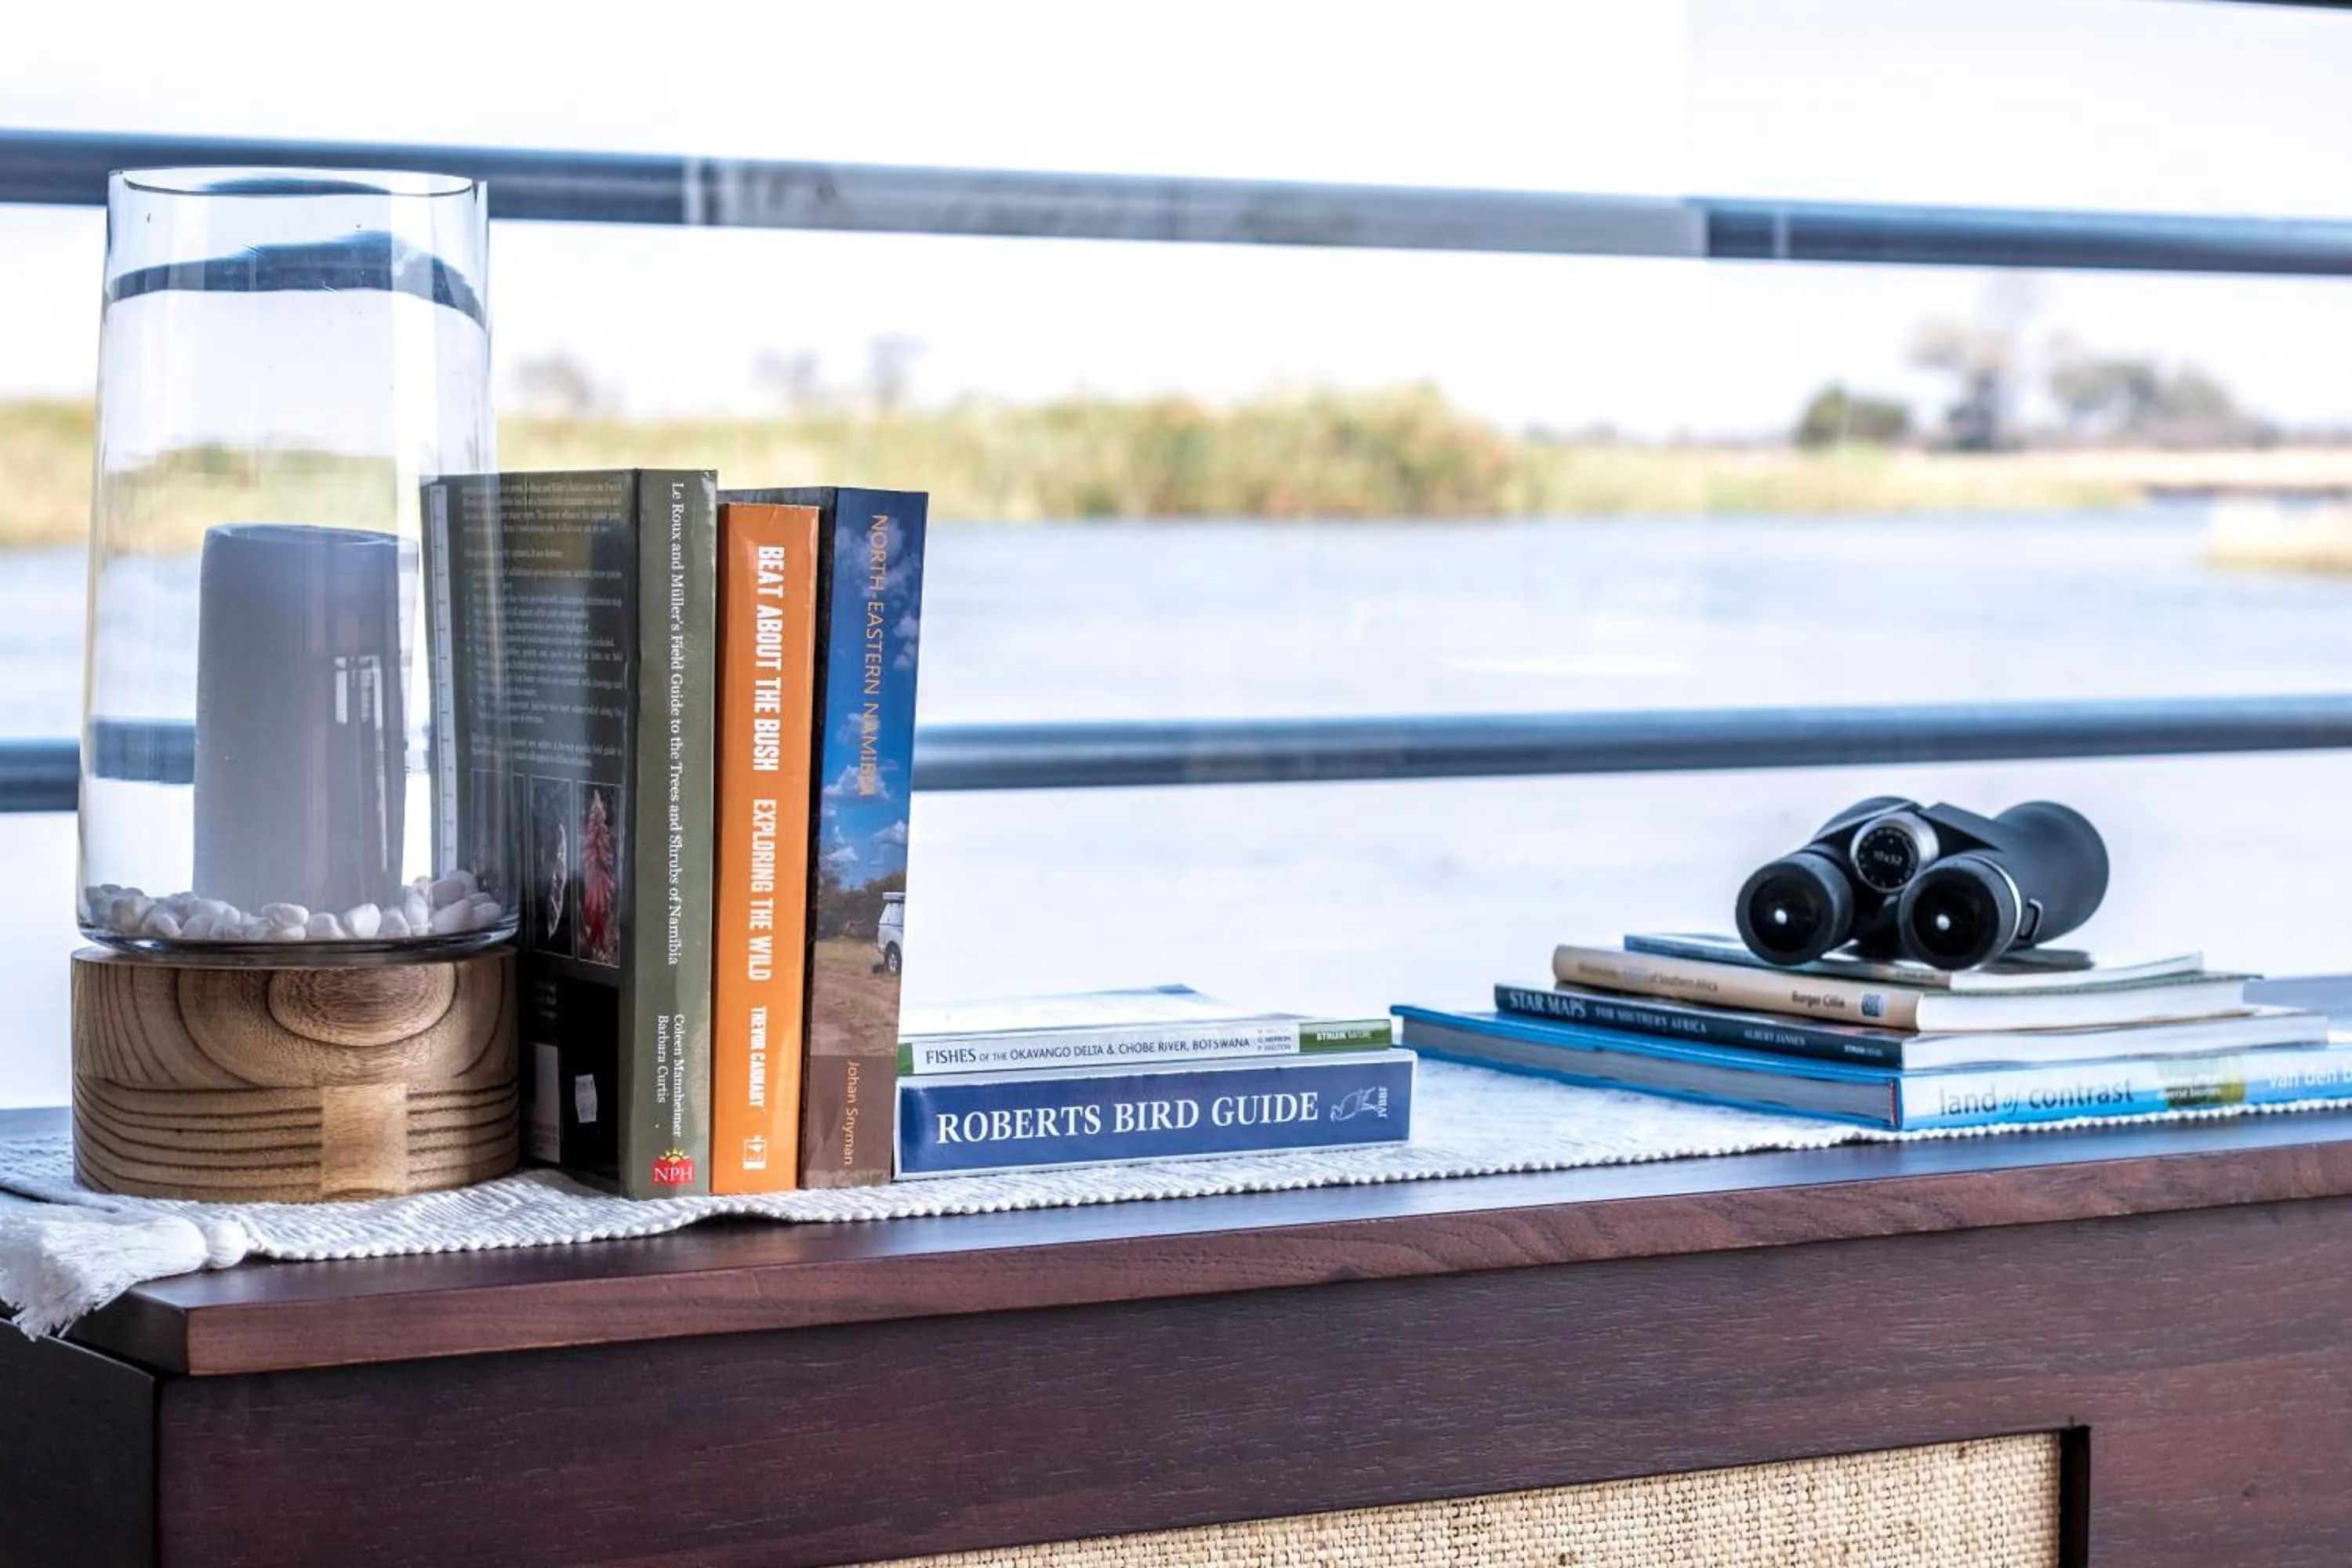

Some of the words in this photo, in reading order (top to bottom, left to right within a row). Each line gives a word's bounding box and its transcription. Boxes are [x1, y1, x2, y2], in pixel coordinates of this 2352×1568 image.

[672, 483, 684, 499] Le
[672, 503, 684, 539] Roux
[672, 543, 684, 570] and
[757, 546, 785, 598] BEAT
[670, 635, 684, 670] Field
[755, 604, 783, 670] ABOUT
[670, 673, 684, 716] Guide
[754, 677, 782, 713] THE
[670, 720, 681, 734] to
[753, 718, 780, 771] BUSH
[670, 737, 683, 760] the
[670, 762, 683, 801] Trees
[669, 804, 683, 831] and
[669, 835, 683, 884] Shrubs
[751, 799, 777, 893] EXPLORING
[669, 887, 682, 904] of
[749, 898, 774, 930] THE
[668, 906, 681, 966] Namibia
[748, 935, 772, 981] WILD
[750, 1005, 768, 1050] TREVOR
[1508, 990, 1544, 1012] STAR
[1547, 995, 1587, 1018] MAPS
[1595, 1005, 1613, 1019] FOR
[1617, 1008, 1668, 1027] SOUTHERN
[1670, 1018, 1708, 1034] AFRICA
[658, 1015, 670, 1062] Barbara
[673, 1014, 685, 1055] Coleen
[926, 1047, 976, 1064] FISHES
[979, 1053, 989, 1062] OF
[993, 1052, 1007, 1061] THE
[1010, 1046, 1071, 1061] OKAVANGO
[1073, 1044, 1103, 1057] DELTA
[1106, 1045, 1115, 1055] &
[1118, 1041, 1155, 1054] CHOBE
[1158, 1040, 1189, 1052] RIVER,
[1192, 1037, 1250, 1051] BOTSWANA
[657, 1066, 669, 1103] Curtis
[673, 1058, 685, 1138] Mannheimer
[847, 1060, 860, 1103] Johan
[1940, 1084, 1997, 1116] land
[2003, 1087, 2021, 1117] of
[2028, 1079, 2135, 1110] contrast
[2269, 1074, 2299, 1088] van
[842, 1108, 858, 1165] Snyman
[935, 1104, 1101, 1144] ROBERTS
[1113, 1098, 1200, 1134] BIRD
[1211, 1091, 1319, 1127] GUIDE
[653, 1166, 693, 1182] NPH
